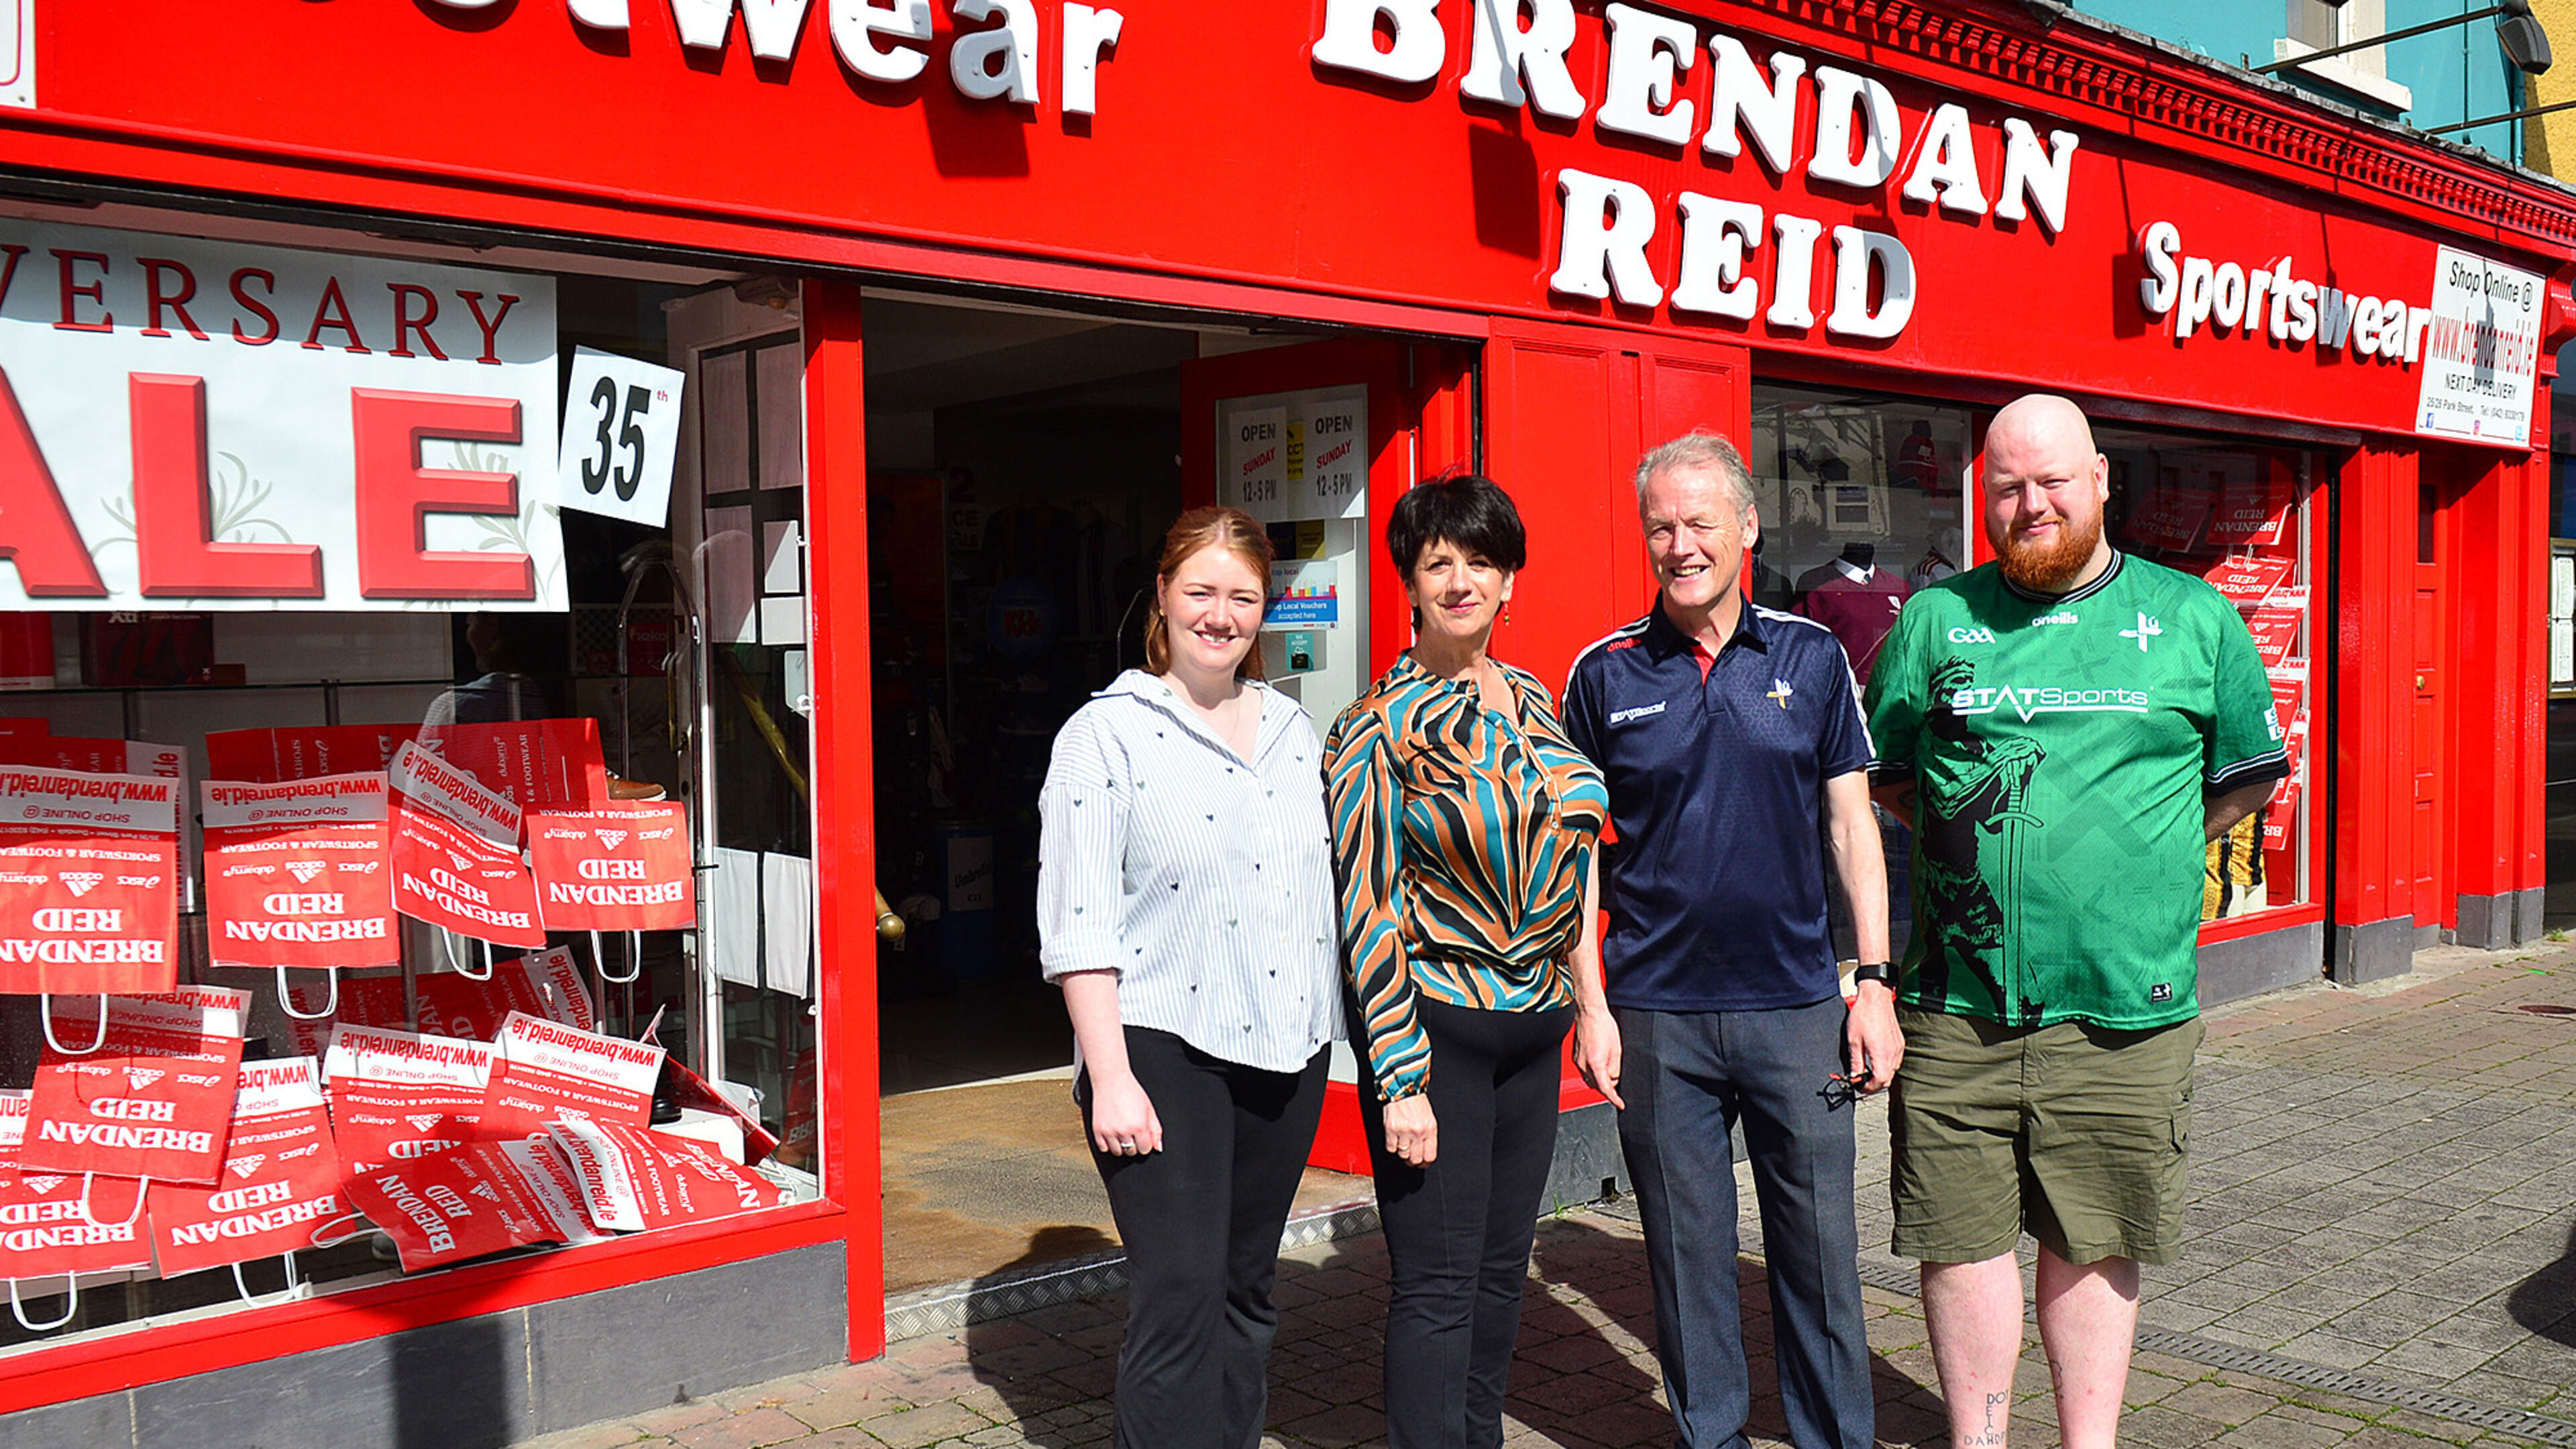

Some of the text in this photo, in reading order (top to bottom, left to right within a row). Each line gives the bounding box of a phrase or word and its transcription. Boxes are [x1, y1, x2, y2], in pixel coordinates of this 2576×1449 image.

[1312, 0, 2080, 233] BRENDAN
[1550, 168, 1917, 339] REID
[2141, 221, 2432, 363] Sportswear
[2449, 261, 2533, 312] Shop Online @
[2432, 307, 2533, 377] www.brendanreid.ie
[2445, 374, 2517, 400] NEXT DAY DELIVERY
[1242, 423, 1276, 441] OPEN
[1315, 415, 1353, 434] OPEN
[580, 376, 668, 501] 35 th
[1287, 443, 1303, 455] CCT
[1243, 447, 1275, 475] SUNDAY
[1317, 439, 1352, 469] SUNDAY
[1265, 480, 1277, 501] PM
[1340, 473, 1352, 494] PM
[2234, 510, 2265, 519] REID
[2214, 521, 2278, 532] BRENDAN
[2227, 574, 2260, 584] REID
[1948, 627, 1996, 644] GAA
[1951, 685, 2148, 712] STATSports
[519, 734, 533, 786] FOOTWEAR
[0, 773, 167, 804] www.brendanreid.i
[211, 779, 381, 805] www.brendanreid.ie
[403, 751, 519, 831] www.brendanreid.ie
[23, 805, 130, 823] SHOP ONLINE @
[248, 807, 348, 820] SHOP ONLINE @
[433, 798, 464, 821] ONLINE
[606, 809, 672, 818] SPORTSWEAR
[400, 809, 448, 837] FOOTWEAR
[465, 818, 488, 837] SHOP
[0, 847, 161, 862] SPORTSWEAR & FOOTWEA
[221, 841, 287, 853] FOOTWEAR
[302, 841, 378, 849] SPORTSWEAR
[578, 859, 646, 879] REID
[430, 868, 490, 906] REID
[549, 881, 684, 905] BRENDAN
[264, 893, 344, 915] REID
[402, 873, 531, 928] BRENDAN
[32, 908, 122, 931] REID
[225, 918, 386, 942] BRENDAN
[0, 940, 164, 963] BRENDAN
[166, 1018, 201, 1028] SHOP
[340, 1032, 487, 1067] www.brendanreid.ie
[513, 1018, 655, 1067] www.brendanreid.ie
[385, 1068, 426, 1080] ONLINE
[550, 1057, 588, 1073] ONLINE
[591, 1068, 620, 1080] SHOP
[503, 1077, 560, 1095] FOOTWEAR
[89, 1097, 176, 1122] REID
[246, 1099, 278, 1111] SHOP
[346, 1094, 406, 1106] FOOTWEAR
[419, 1097, 484, 1105] PORTSWEAR
[573, 1092, 639, 1112] SPORTSWEAR
[38, 1120, 213, 1153] BRENDAN
[237, 1125, 317, 1145] SPORTSWEAR
[683, 1142, 760, 1208] BRENDAN
[208, 1180, 293, 1213] REID
[425, 1184, 473, 1218] REID
[647, 1167, 669, 1216] FOOTWEAR
[0, 1199, 87, 1224] REID
[376, 1175, 456, 1254] BRENDAN
[547, 1198, 565, 1218] SHOP
[172, 1195, 337, 1246] BRENDAN
